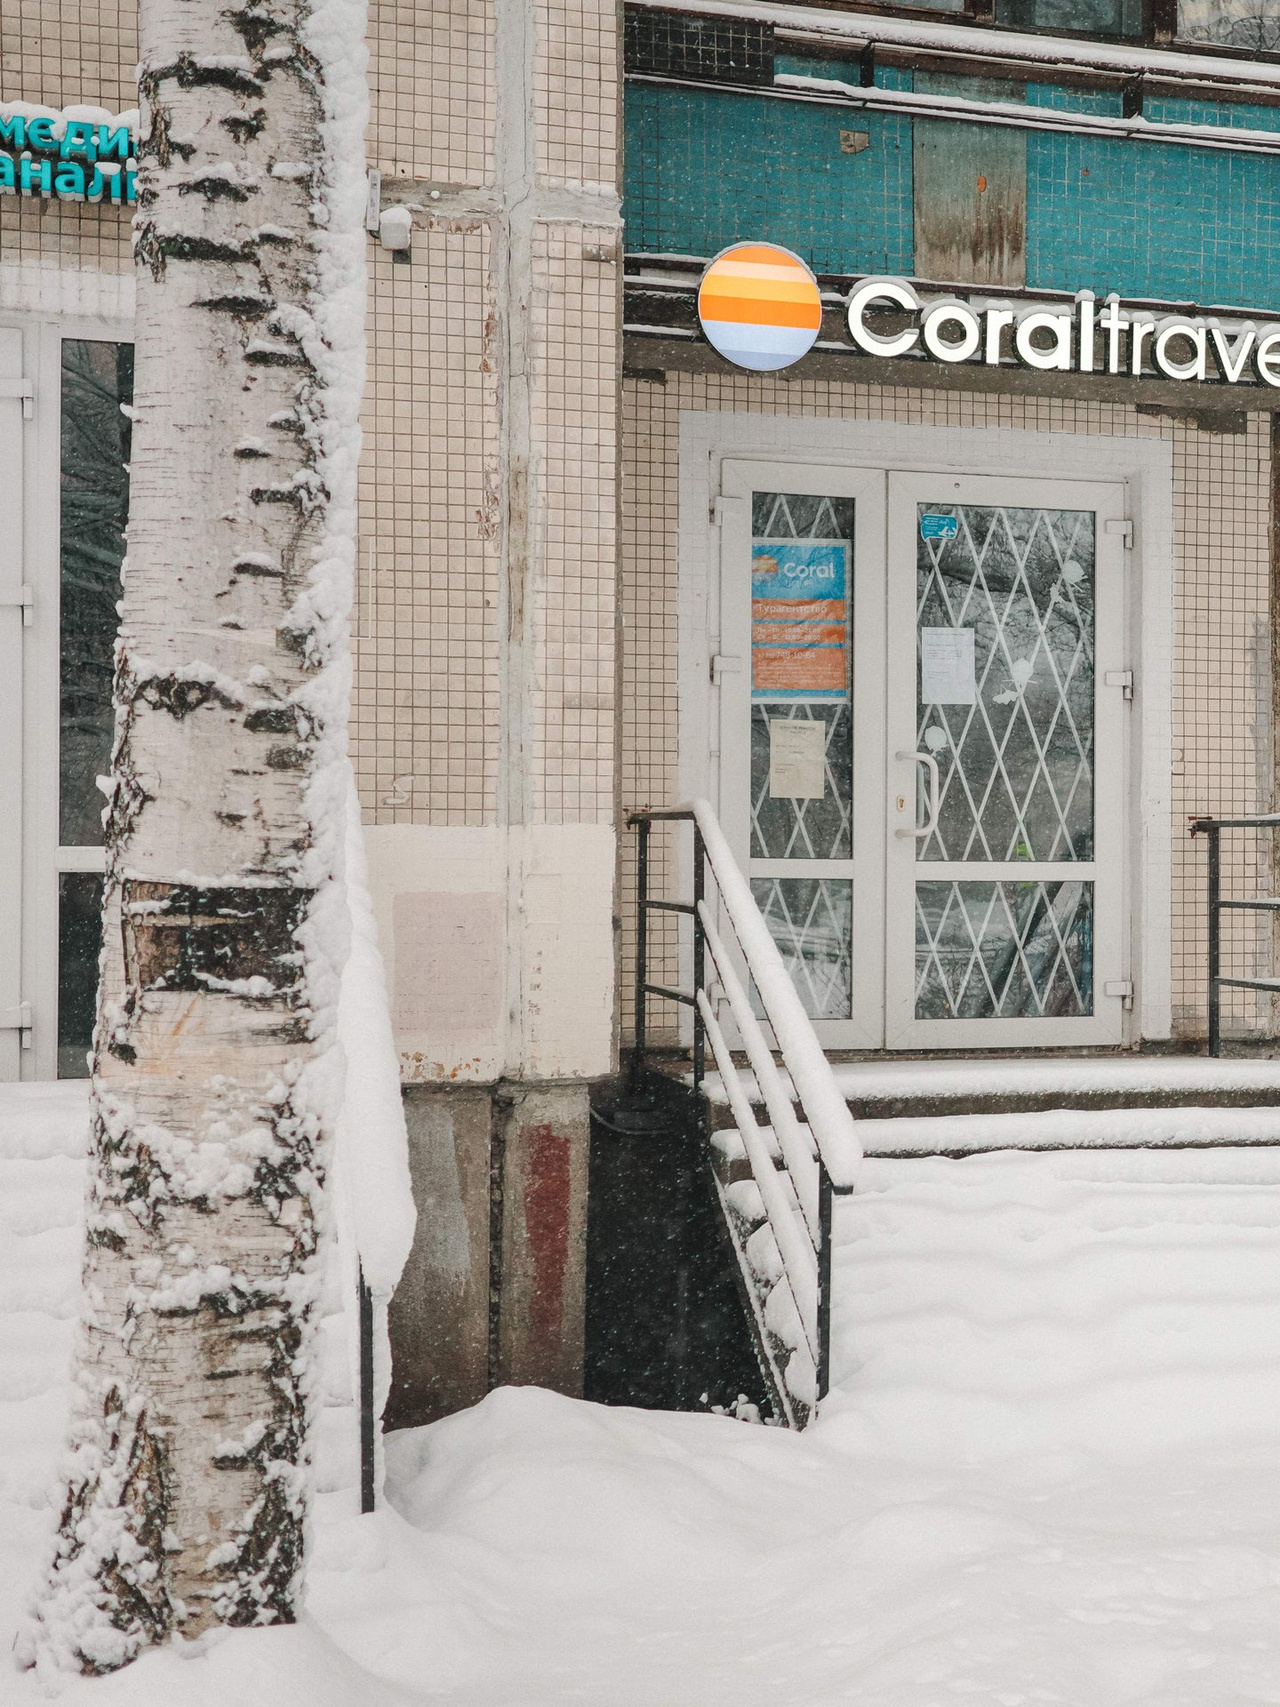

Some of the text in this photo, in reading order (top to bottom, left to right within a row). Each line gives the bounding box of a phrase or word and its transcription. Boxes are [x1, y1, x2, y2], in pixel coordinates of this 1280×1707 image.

[0, 115, 138, 161] меди
[783, 562, 835, 579] Coral
[757, 603, 828, 614] Турагентство
